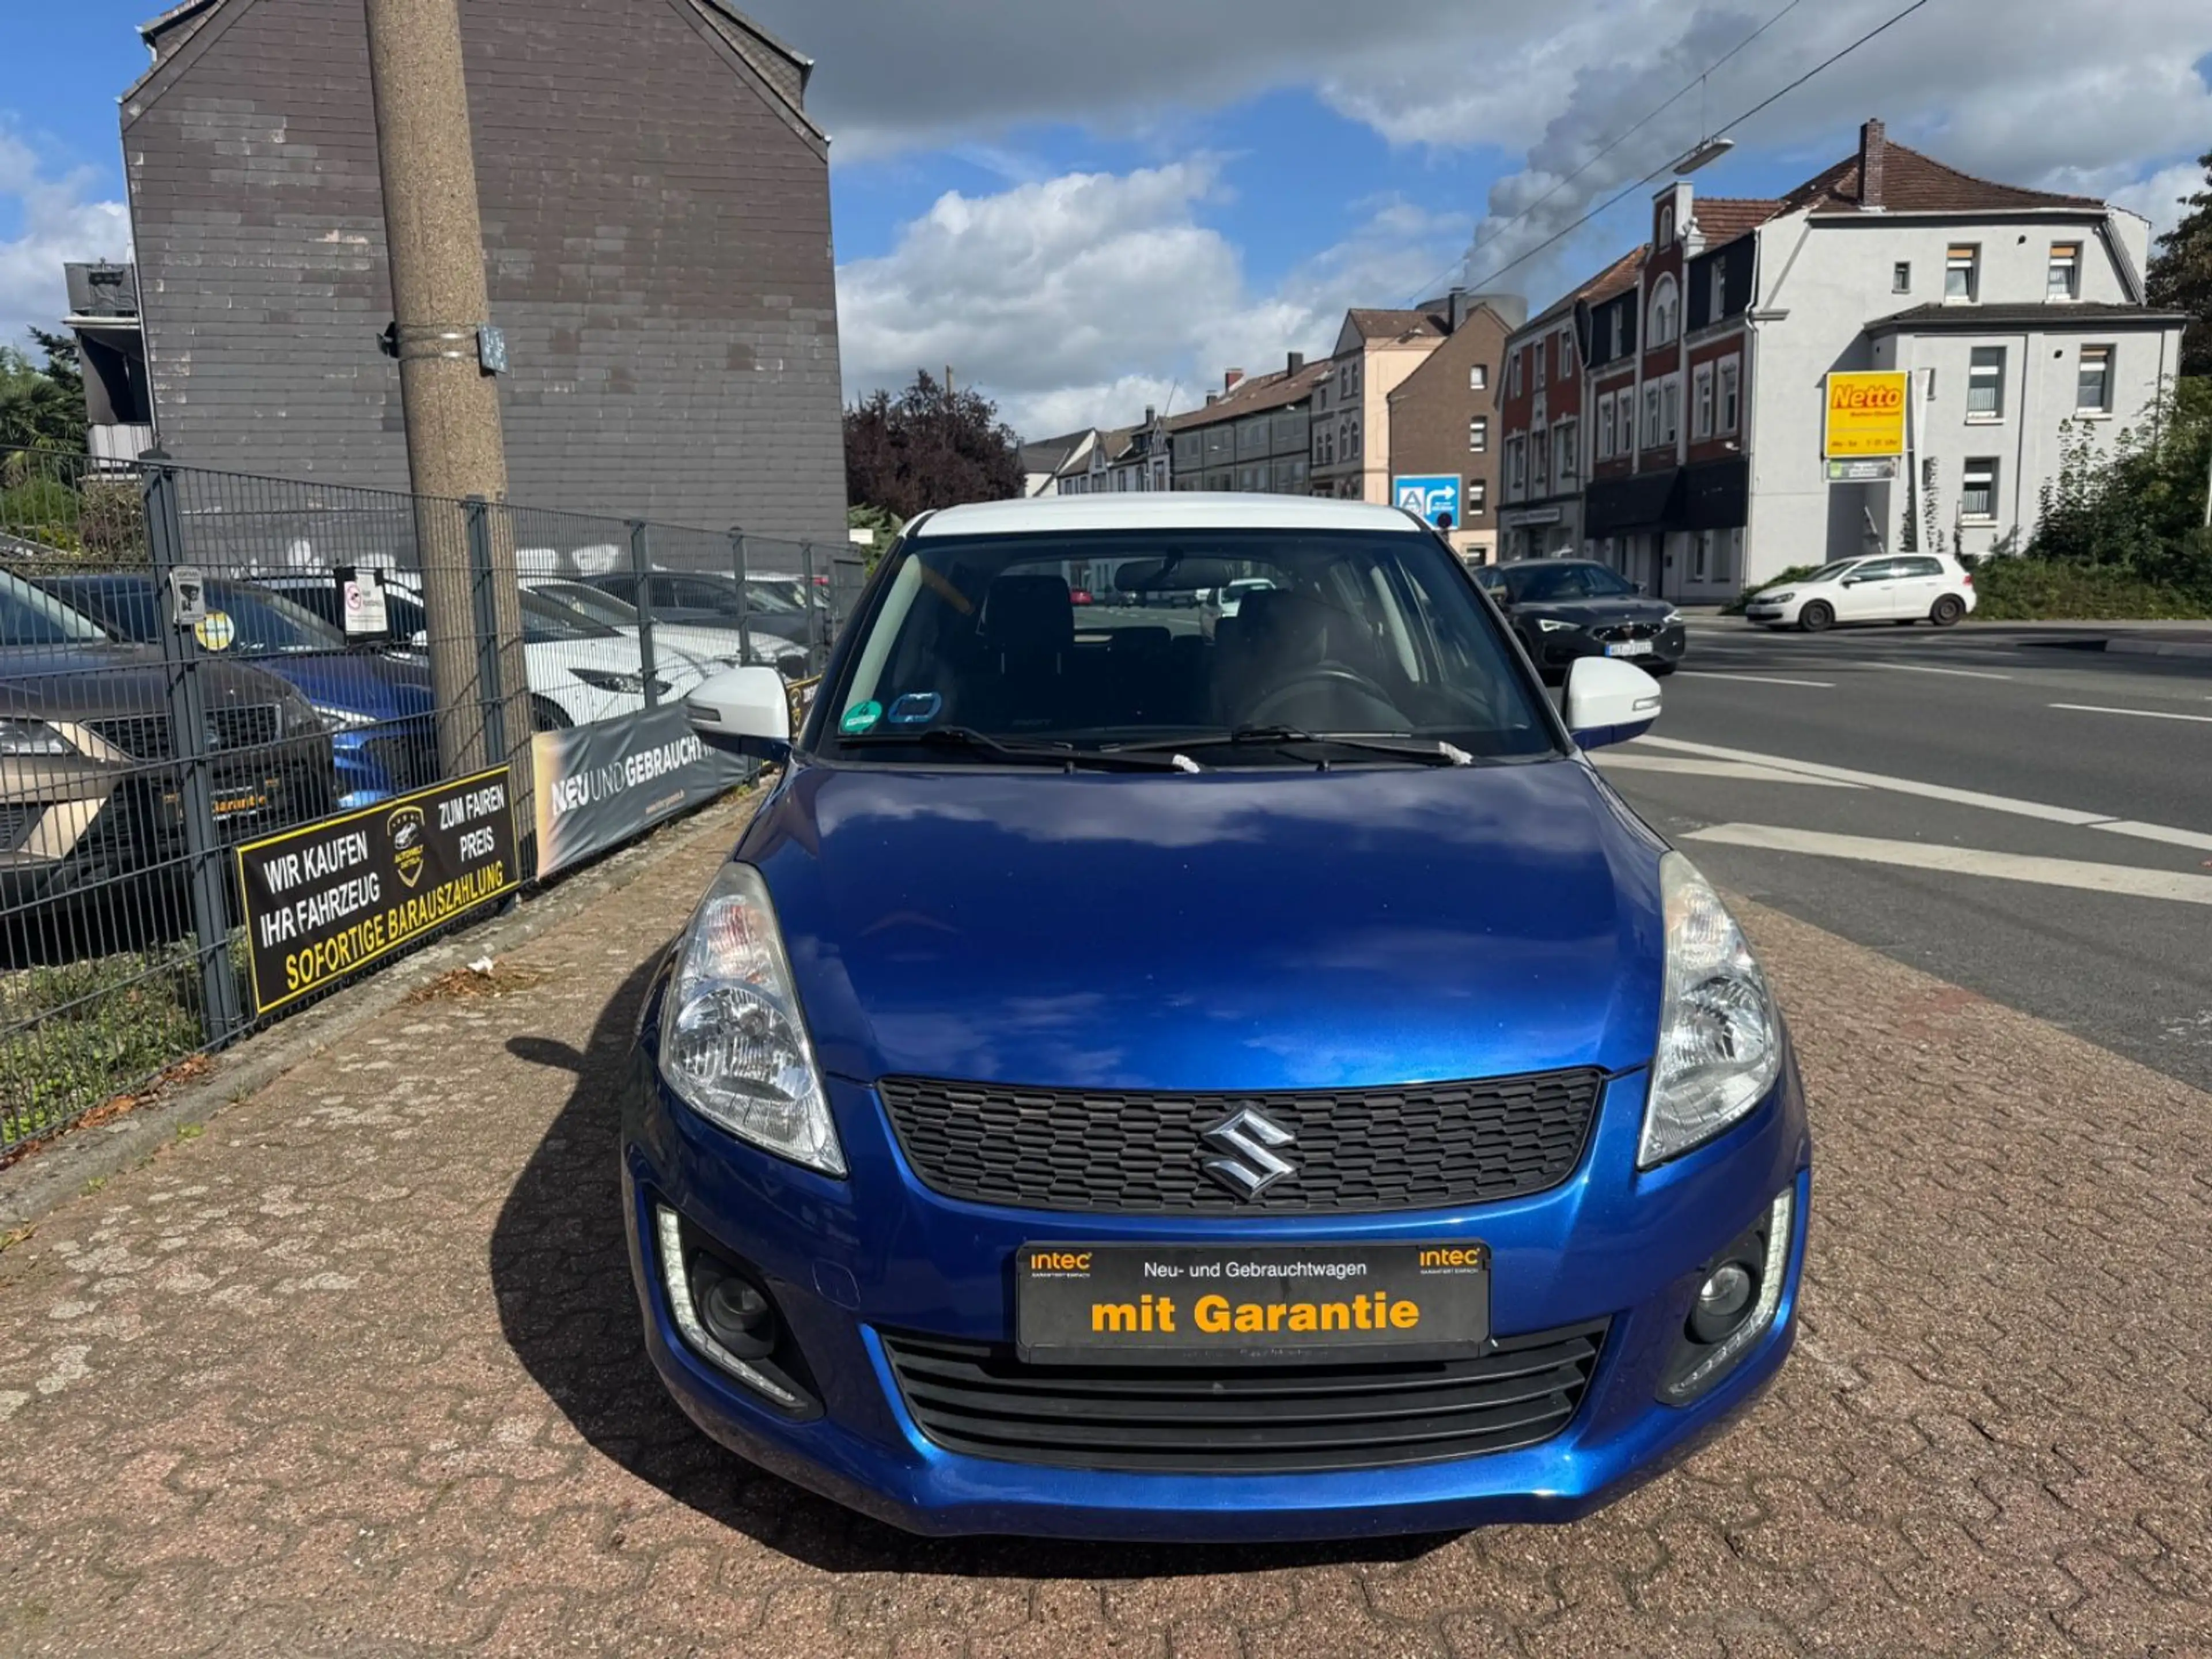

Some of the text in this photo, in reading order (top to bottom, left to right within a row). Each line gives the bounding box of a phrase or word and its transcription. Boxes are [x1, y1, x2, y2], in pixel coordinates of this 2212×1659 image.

[1831, 385, 1902, 409] Netto
[438, 783, 505, 830] ZUM FAIREN
[551, 772, 589, 816] NEU
[590, 762, 626, 800] UND
[263, 830, 368, 894] WIR KAUFEN
[460, 826, 495, 862] PREIS
[260, 872, 380, 948] IHR FAHRZEUG
[286, 860, 503, 990] SOFORTIGE BARAUSZAHLUNG
[1031, 1252, 1090, 1270] intec
[1145, 1261, 1367, 1280] Neu- und Gebrauchtwagen
[1420, 1249, 1478, 1266] intec
[1092, 1291, 1419, 1332] mit Garantie
